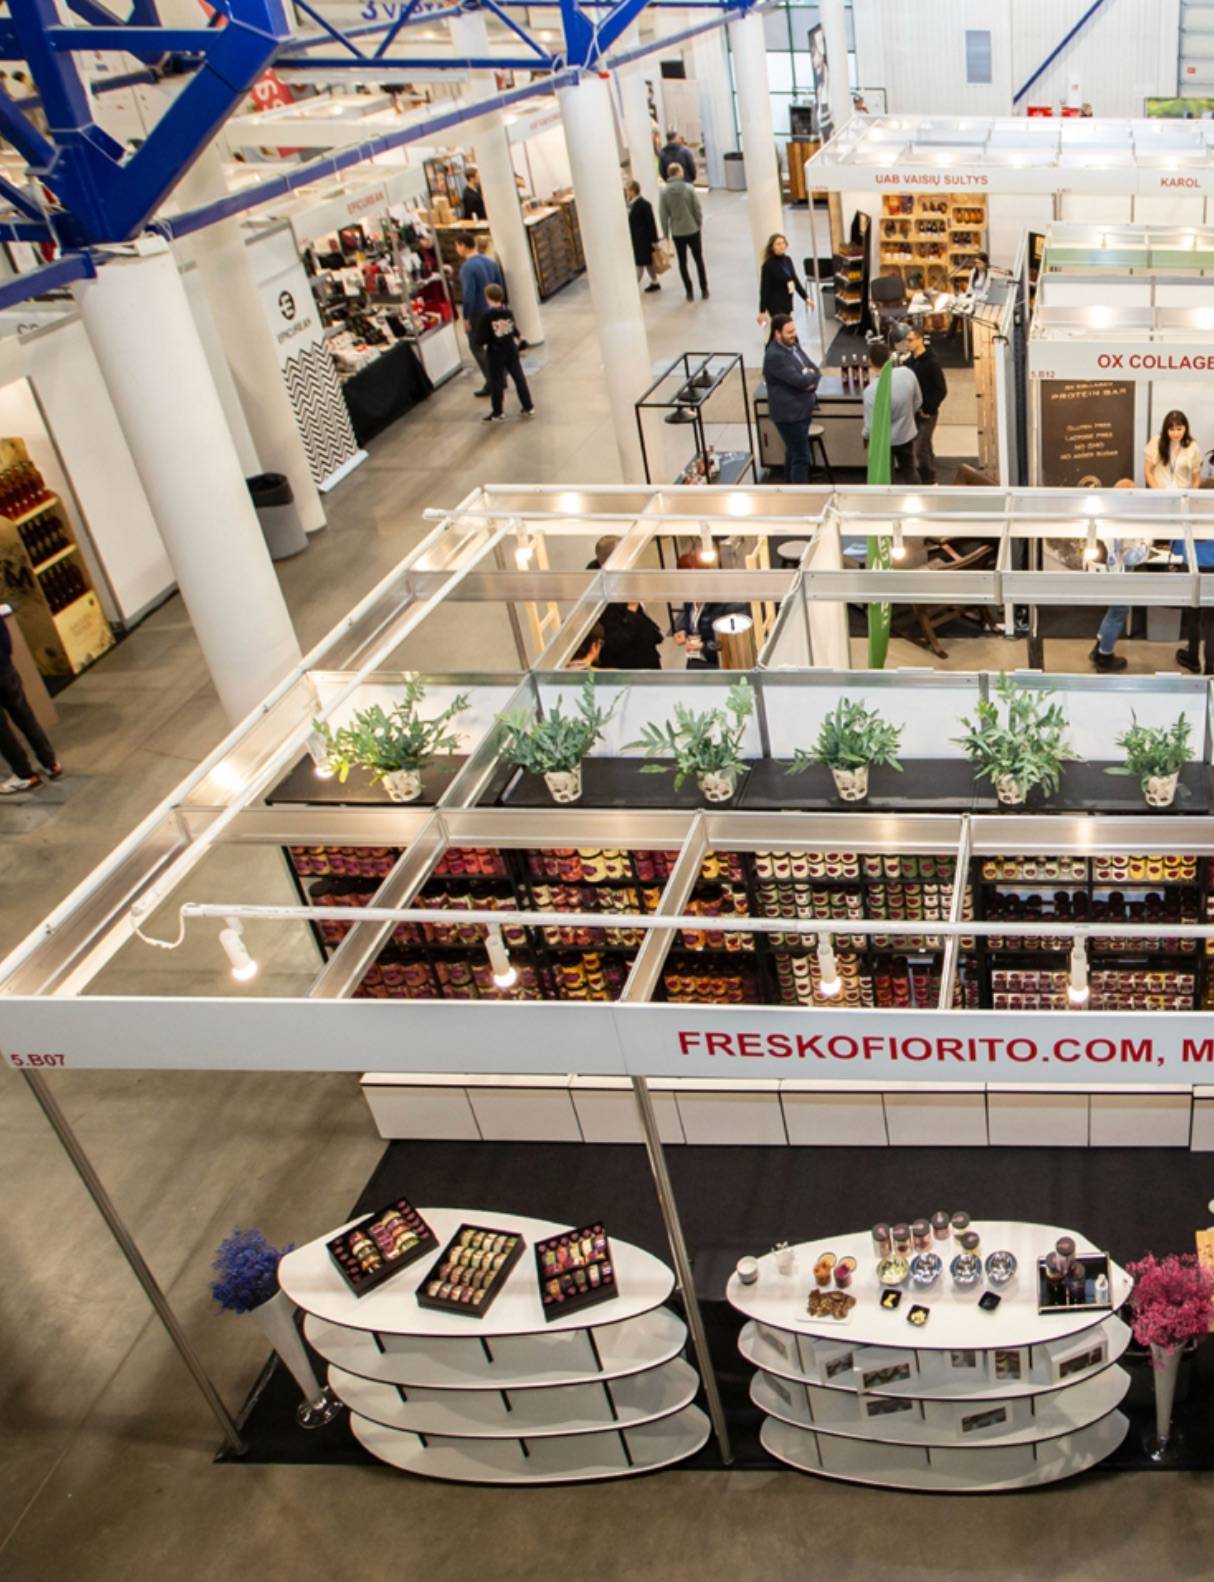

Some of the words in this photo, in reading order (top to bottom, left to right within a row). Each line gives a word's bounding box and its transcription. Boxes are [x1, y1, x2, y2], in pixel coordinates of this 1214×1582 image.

[875, 174, 900, 184] UAB
[903, 174, 941, 186] VAISIŲ
[944, 175, 989, 185] SULTYS
[1160, 177, 1201, 188] KAROL
[1097, 354, 1123, 369] OX
[1051, 390, 1100, 400] PROTEIN
[1102, 387, 1128, 397] BAR
[1060, 453, 1072, 461] NO
[677, 1030, 1165, 1067] FRESKOFIORITO.COM,
[10, 1054, 66, 1067] 5.B07
